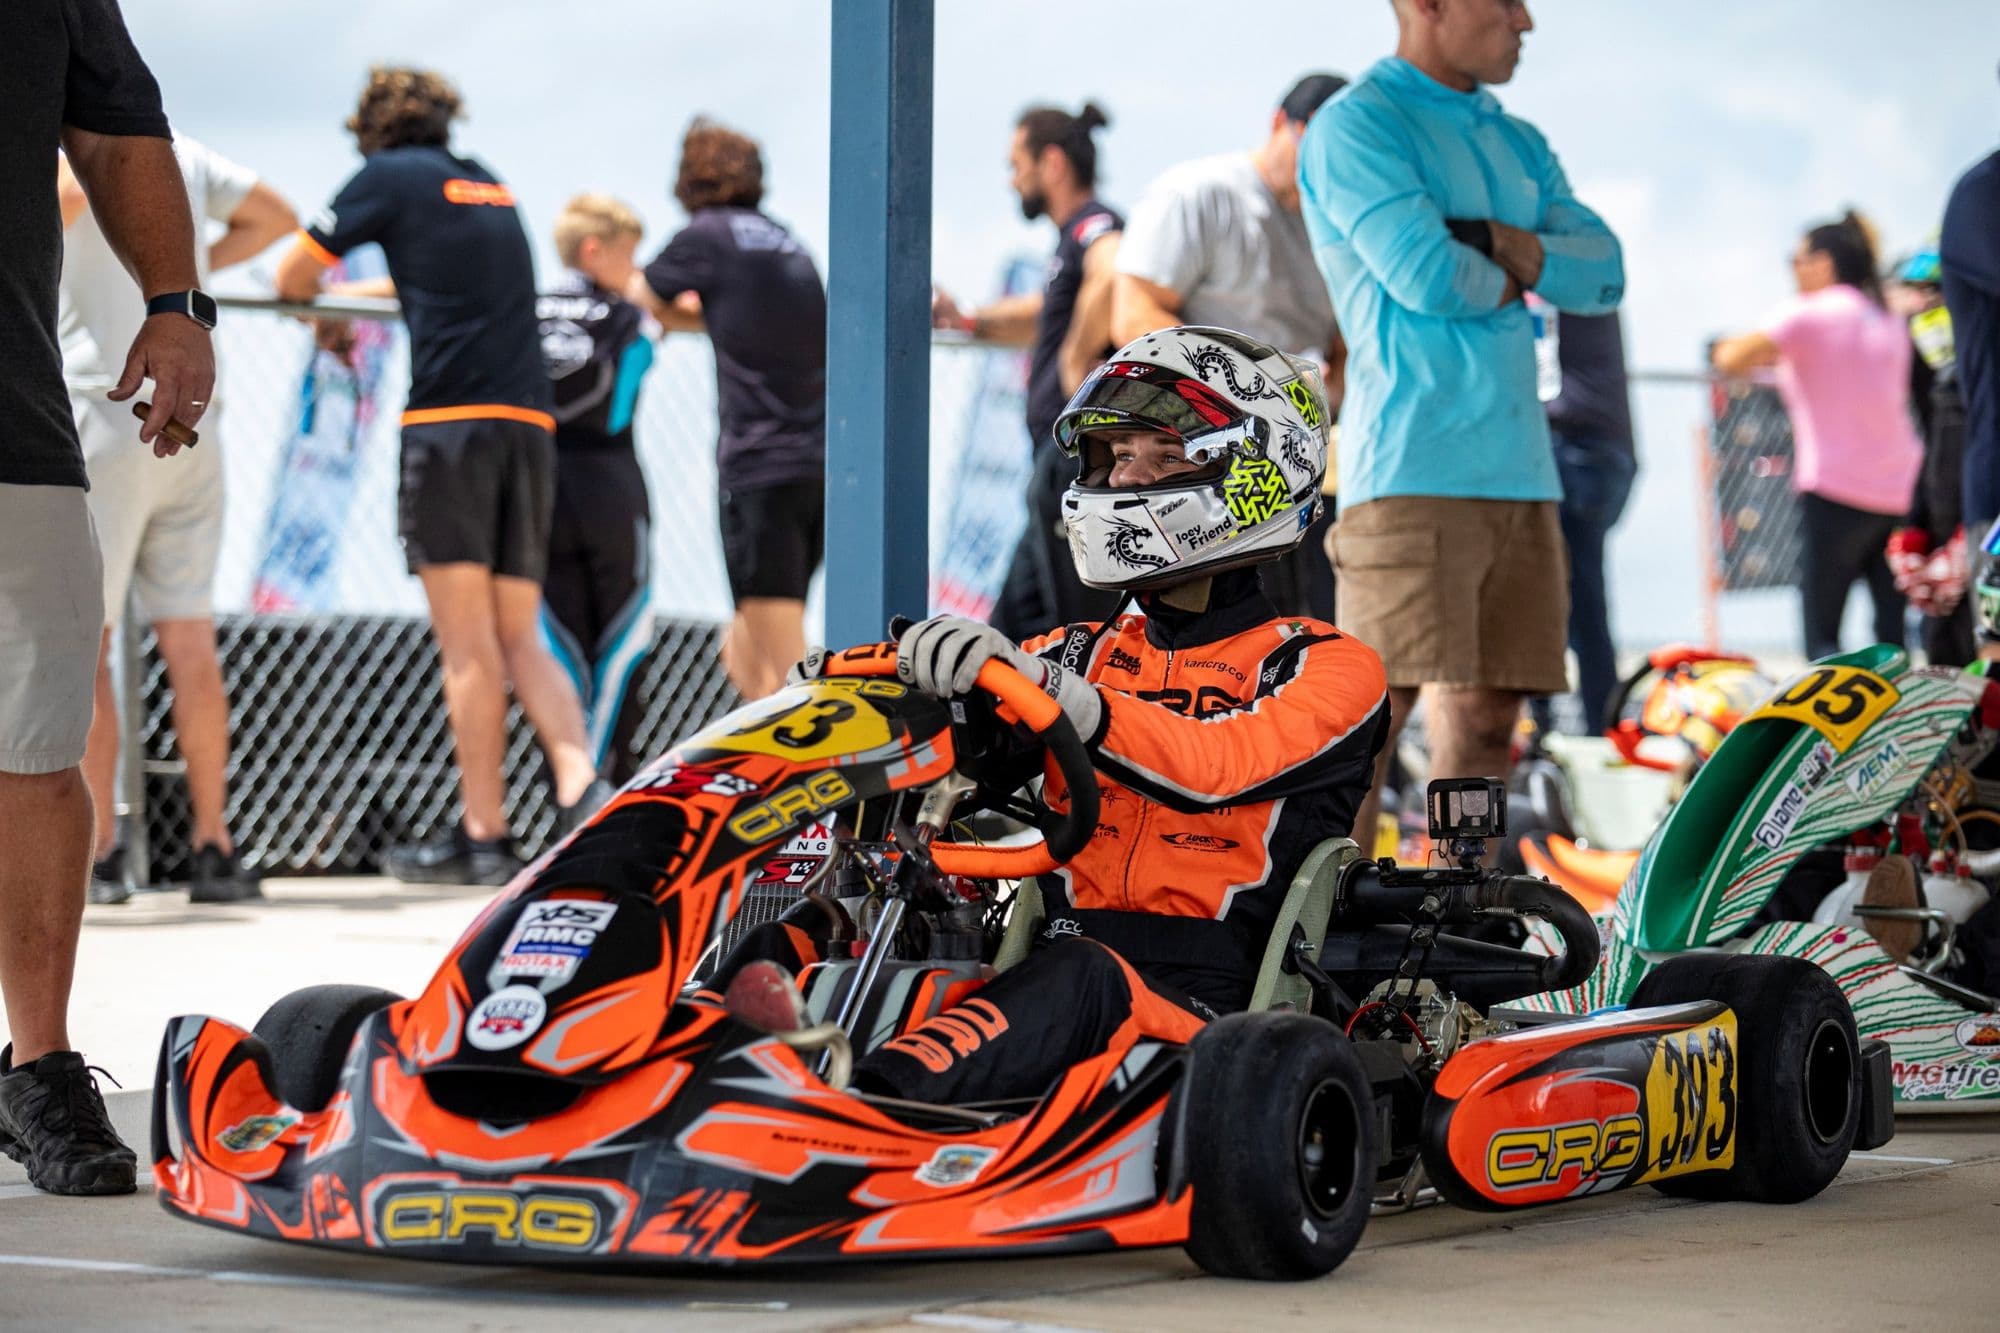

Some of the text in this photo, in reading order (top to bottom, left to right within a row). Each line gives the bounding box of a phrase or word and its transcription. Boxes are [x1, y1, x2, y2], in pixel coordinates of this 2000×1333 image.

[1175, 524, 1201, 545] Joey
[1188, 516, 1233, 550] Friend
[1857, 744, 1899, 792] AEM
[729, 770, 855, 844] CRG
[521, 927, 597, 946] RMC
[502, 955, 568, 969] ROTAX
[1892, 1062, 2000, 1088] MGtire
[1657, 1026, 1736, 1173] 393
[1487, 1114, 1643, 1192] CRG
[381, 1194, 597, 1246] CRG
